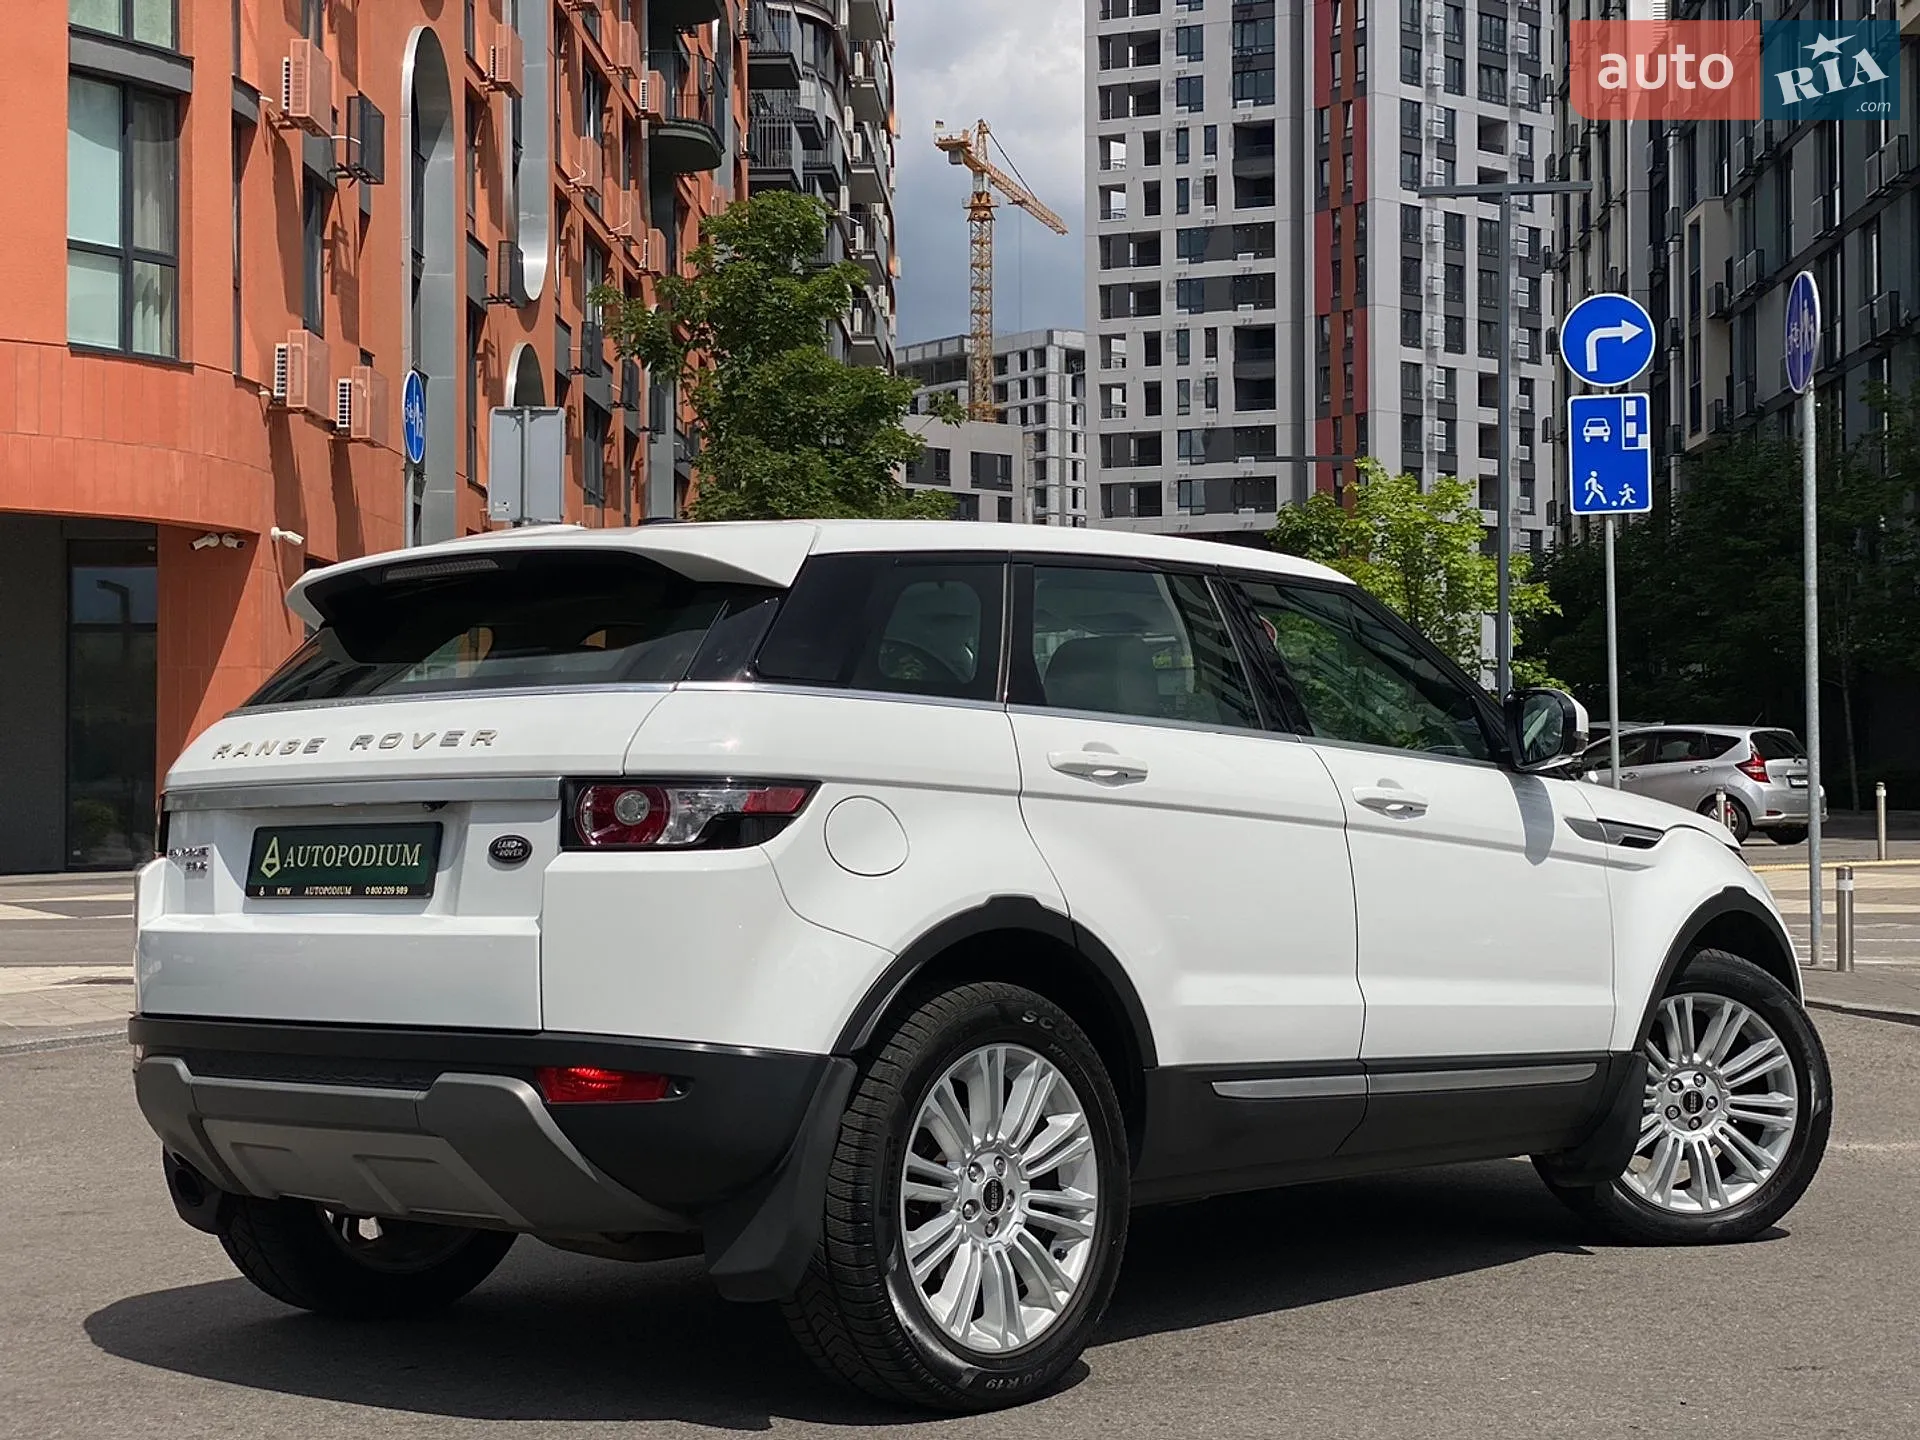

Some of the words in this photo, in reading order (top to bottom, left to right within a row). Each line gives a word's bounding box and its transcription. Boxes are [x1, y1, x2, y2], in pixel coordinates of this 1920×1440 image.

[211, 737, 328, 760] RANGE
[349, 729, 498, 751] ROVER
[284, 843, 422, 868] AUTOPODIUM
[304, 886, 352, 895] AUTOPODIUM
